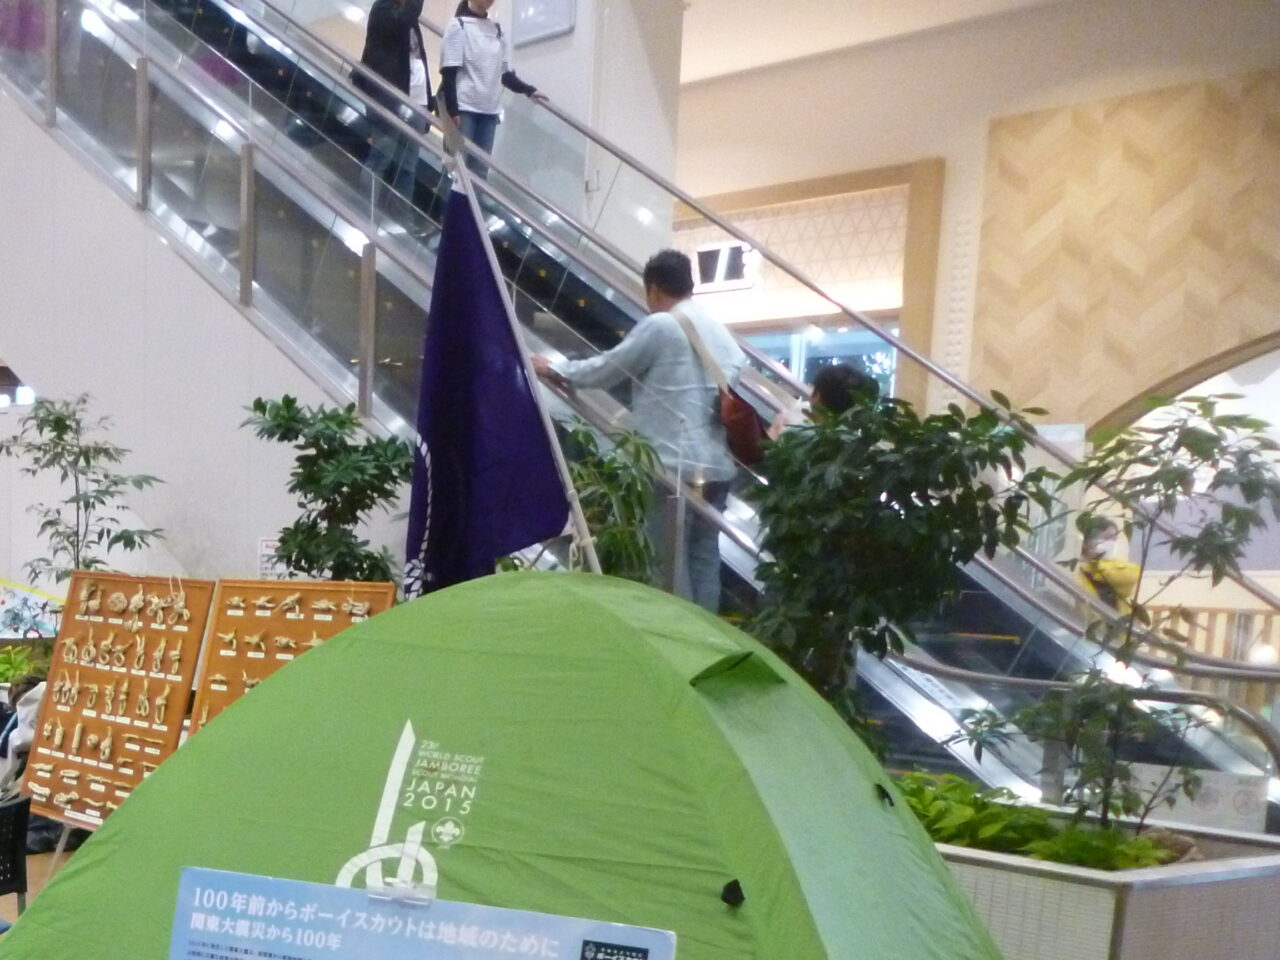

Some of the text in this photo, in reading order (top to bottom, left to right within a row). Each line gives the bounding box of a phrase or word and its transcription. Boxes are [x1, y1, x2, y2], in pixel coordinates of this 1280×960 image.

[414, 759, 482, 775] JAMBOREE
[406, 778, 476, 799] JAPAN
[403, 792, 472, 814] 2015
[190, 912, 343, 951] 関東大震災から100年
[193, 887, 560, 958] 100年前からボーイスカウトは地域のために
